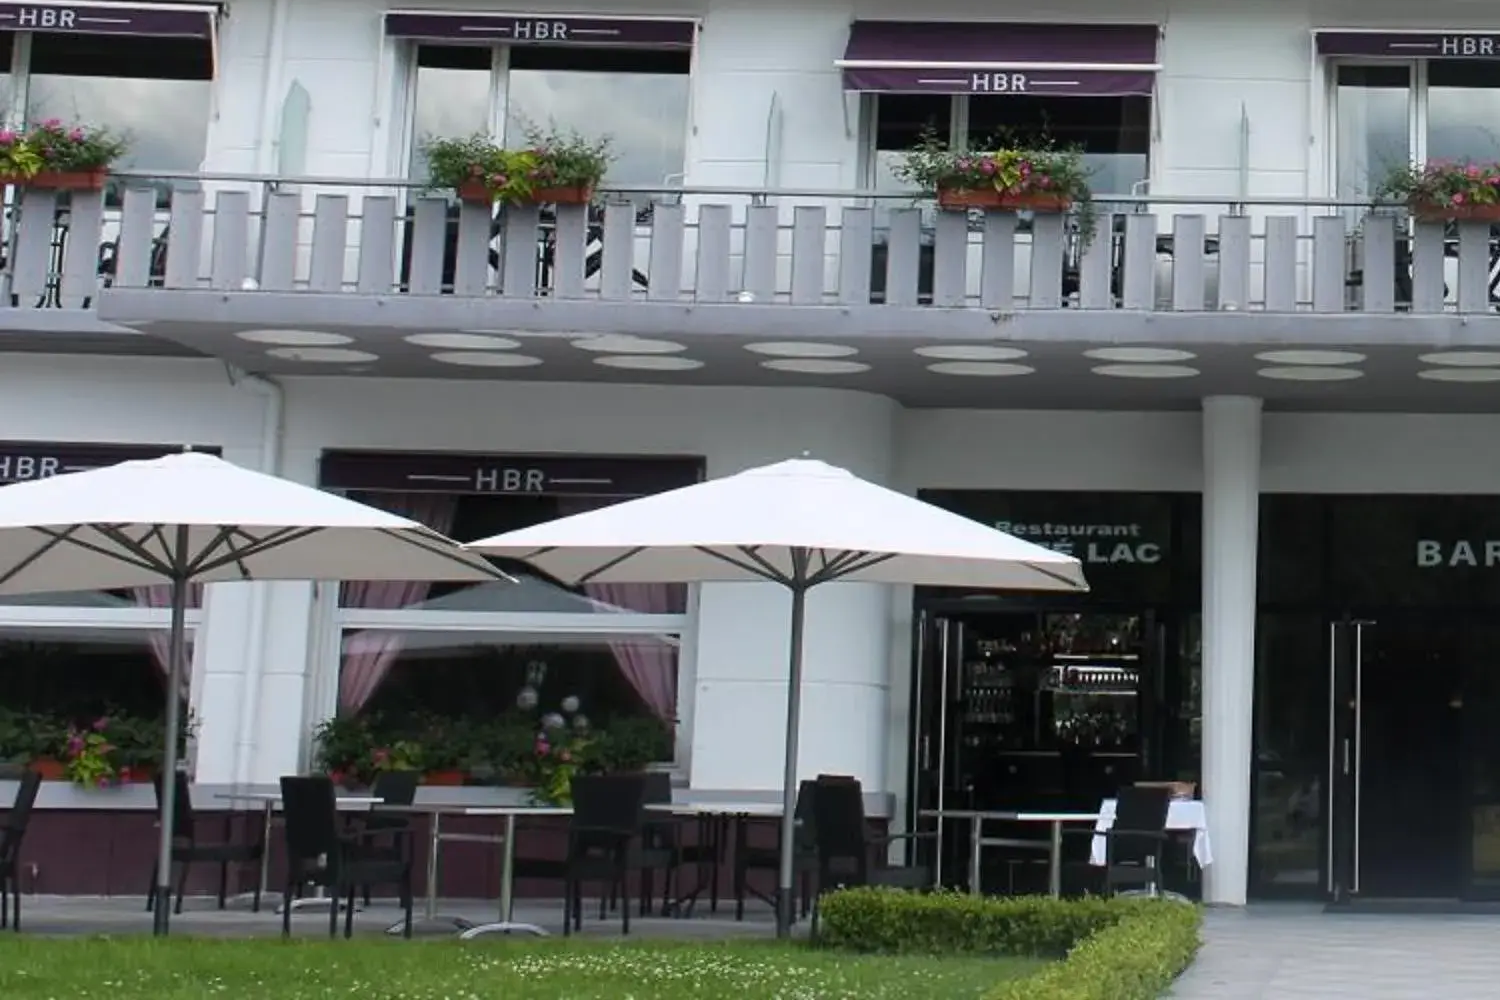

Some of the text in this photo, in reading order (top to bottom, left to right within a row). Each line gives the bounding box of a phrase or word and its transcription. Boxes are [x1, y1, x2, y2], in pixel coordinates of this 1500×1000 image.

[19, 7, 76, 28] HBR
[513, 21, 567, 39] HBR
[1442, 37, 1494, 55] HBR
[972, 73, 1026, 91] HBR
[476, 468, 544, 491] HBR
[993, 521, 1142, 537] Restaurant
[1087, 543, 1162, 563] LAC
